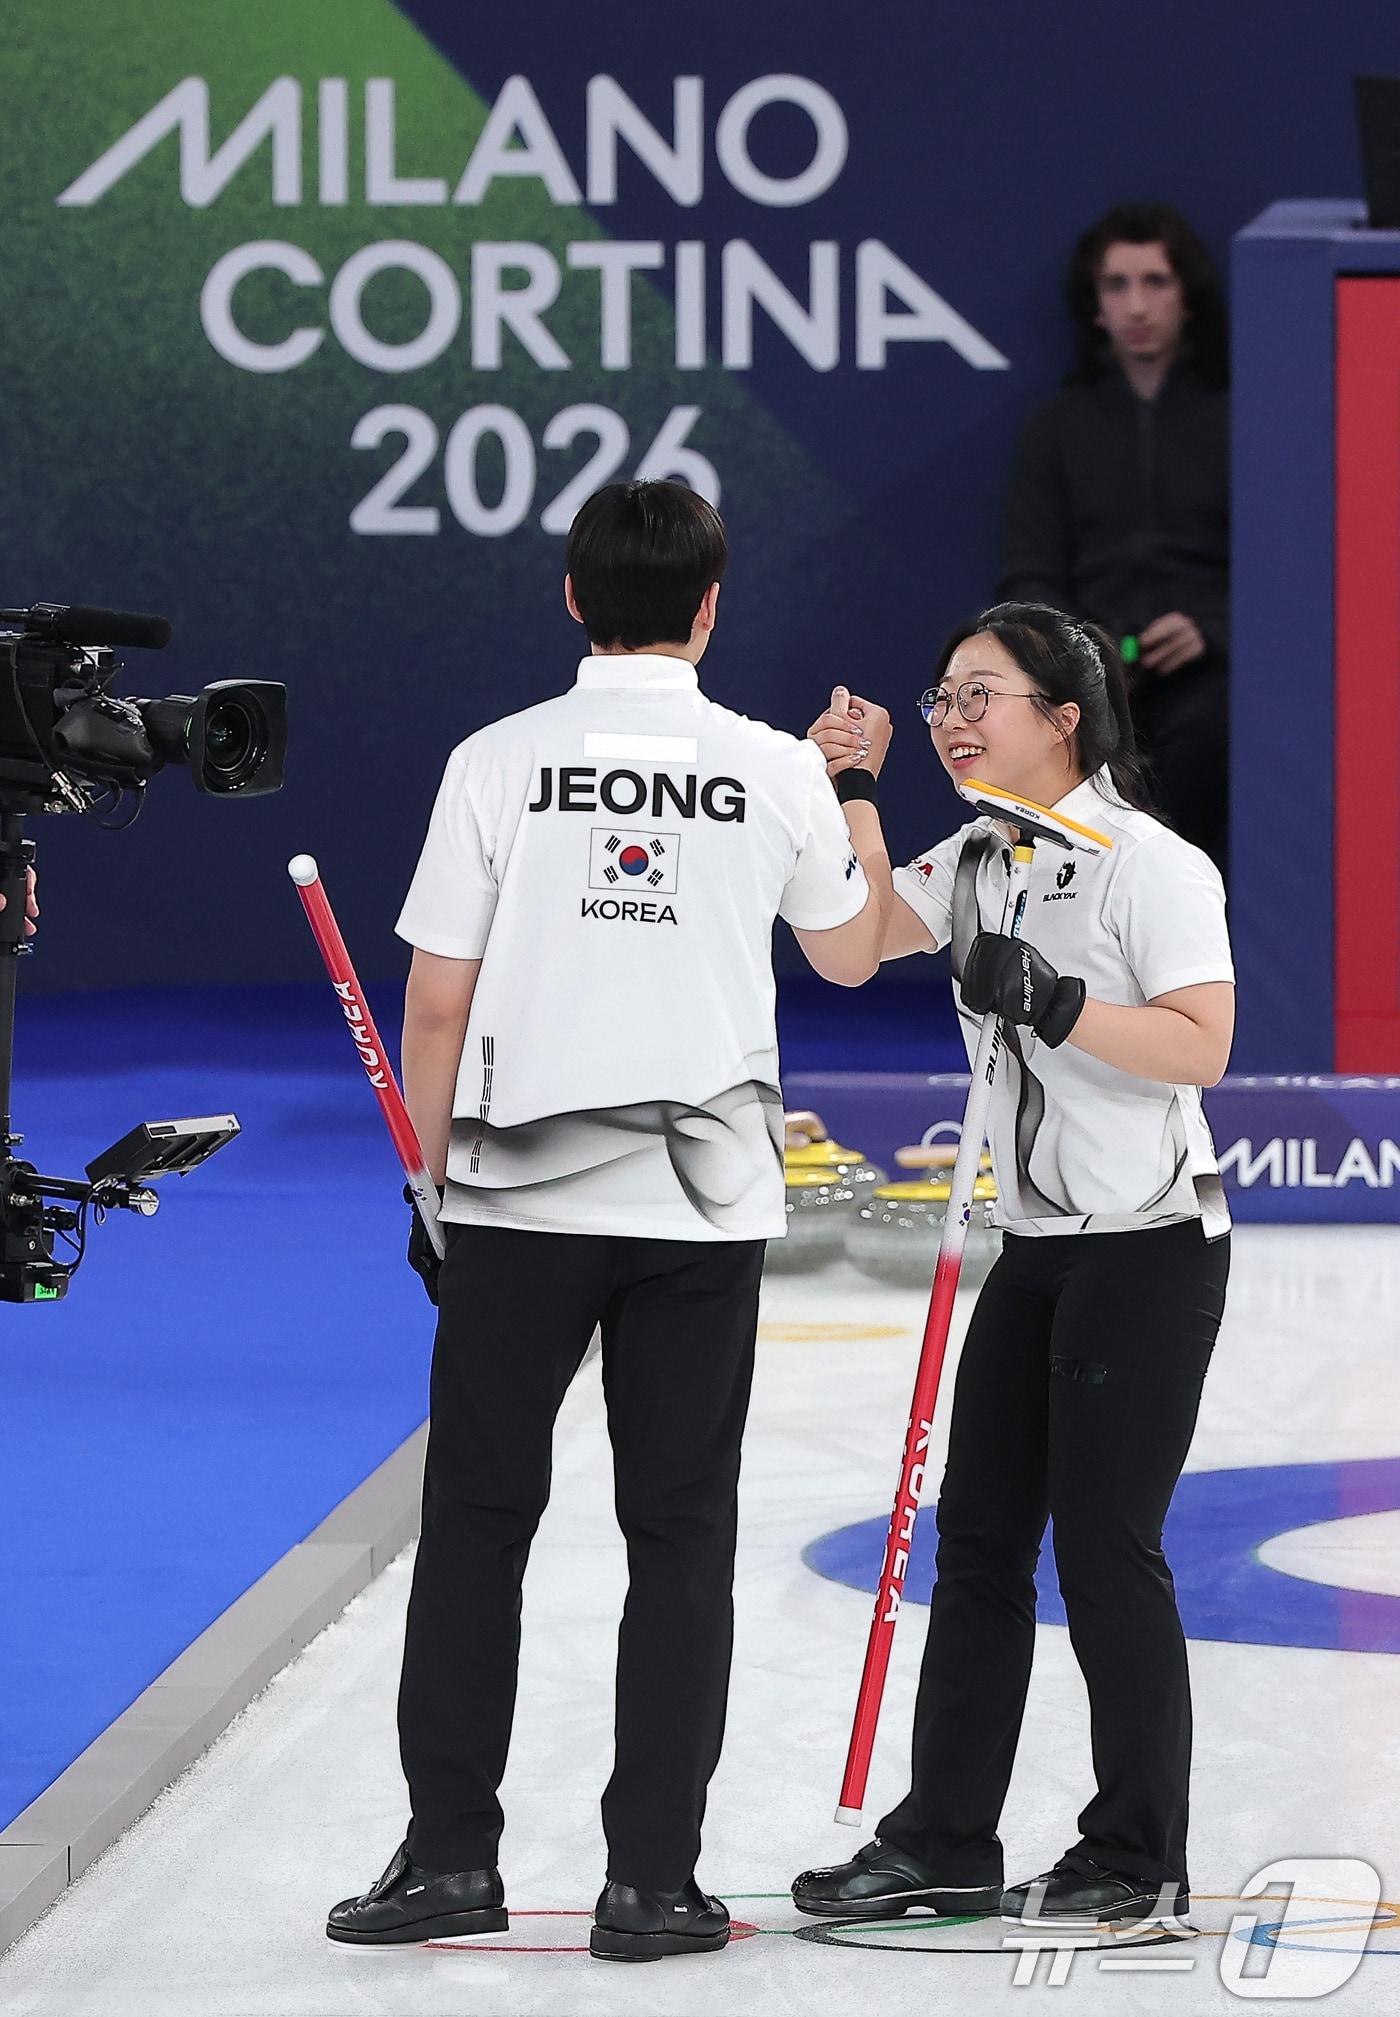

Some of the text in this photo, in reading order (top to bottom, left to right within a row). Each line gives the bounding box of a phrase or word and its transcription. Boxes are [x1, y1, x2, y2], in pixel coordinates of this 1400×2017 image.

[57, 75, 849, 207] MILANO
[200, 238, 1010, 373] CORTINA
[349, 403, 722, 536] 2026
[529, 767, 746, 823] JEONG
[1015, 805, 1040, 820] KOREA
[580, 898, 678, 925] KOREA
[1020, 948, 1034, 1012] Hardline
